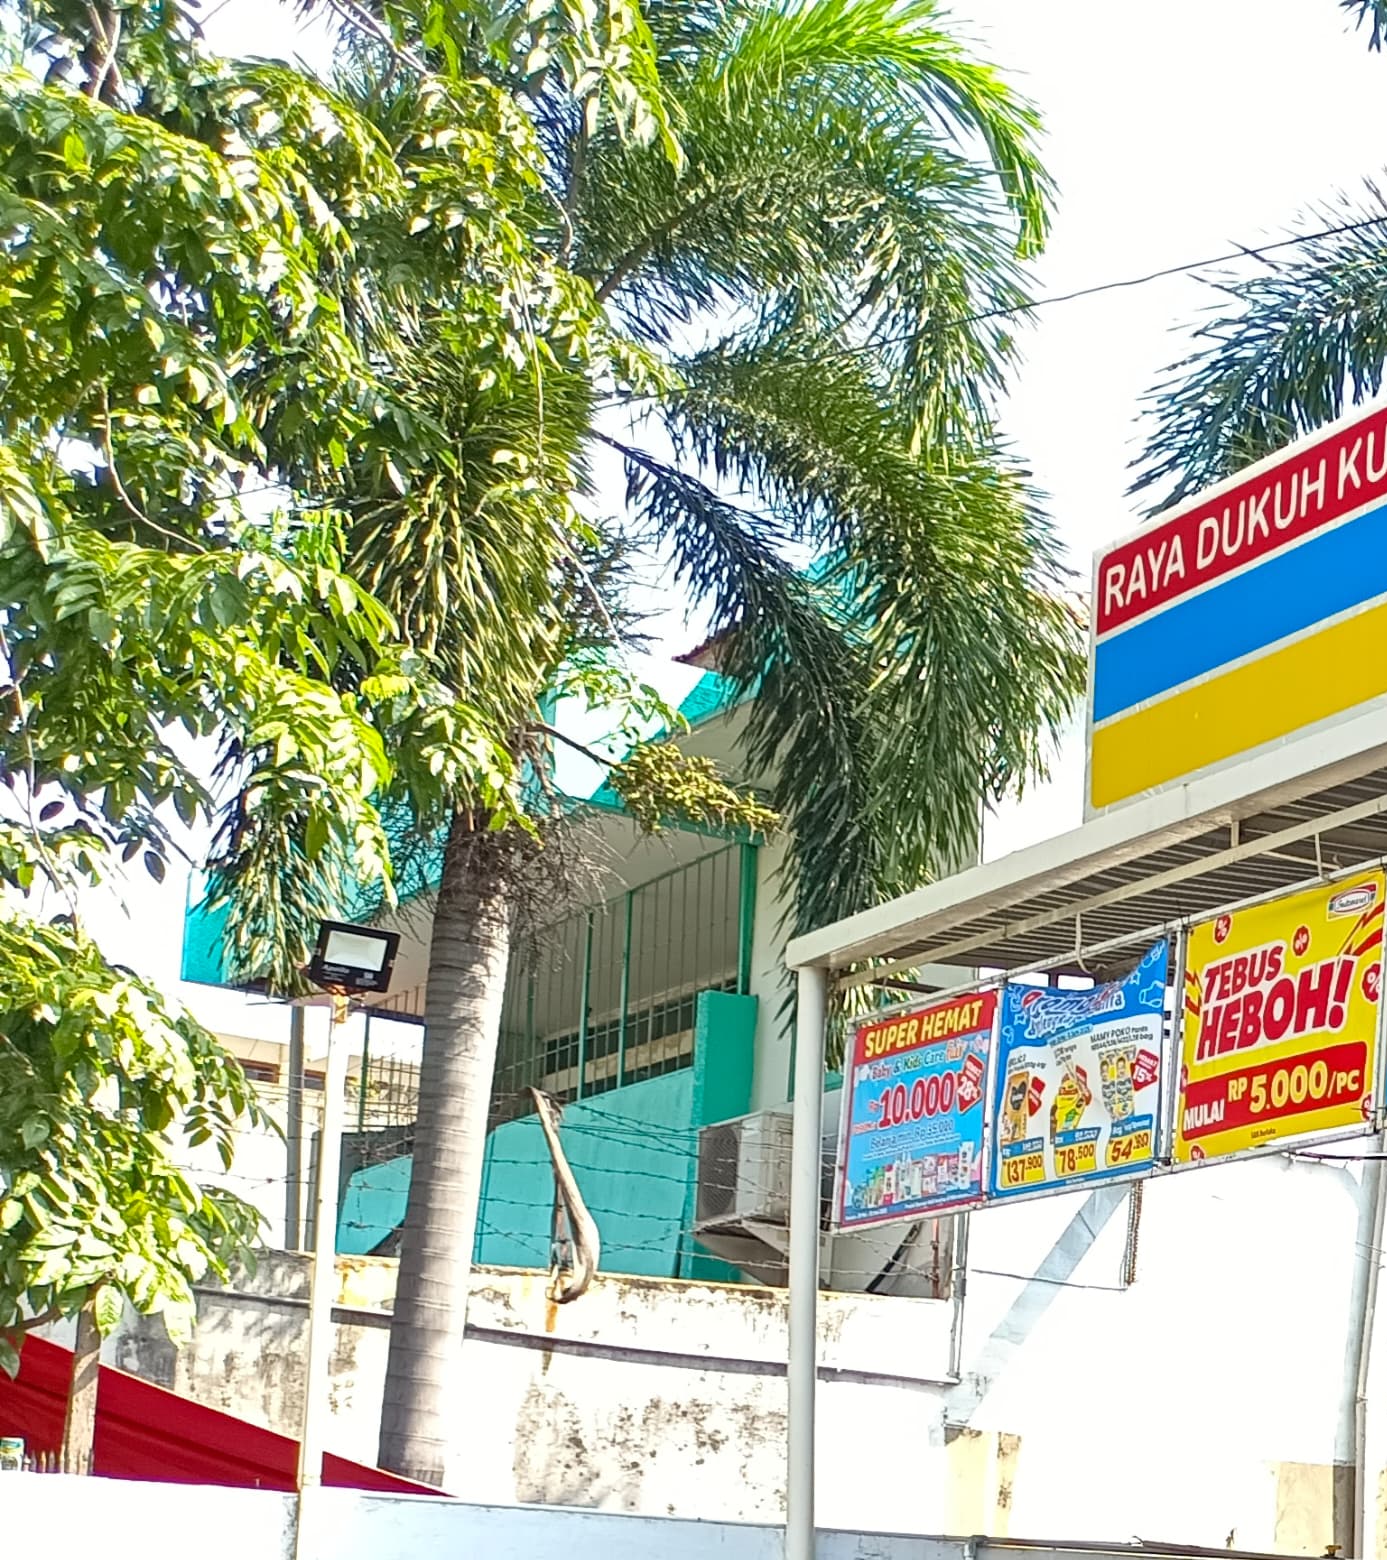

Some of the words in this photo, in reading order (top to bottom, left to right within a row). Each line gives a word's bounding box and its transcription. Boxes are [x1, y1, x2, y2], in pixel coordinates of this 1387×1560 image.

[1104, 534, 1185, 615] RAYA
[1196, 459, 1325, 570] DUKUH
[1204, 945, 1284, 1004] TEBUS
[865, 1022, 917, 1058] SUPER
[920, 999, 983, 1043] HEMAT
[1196, 959, 1355, 1061] HEBOH!
[878, 1071, 955, 1128] 10.000
[1184, 1098, 1225, 1131] MULAI
[1228, 1076, 1248, 1103] RP
